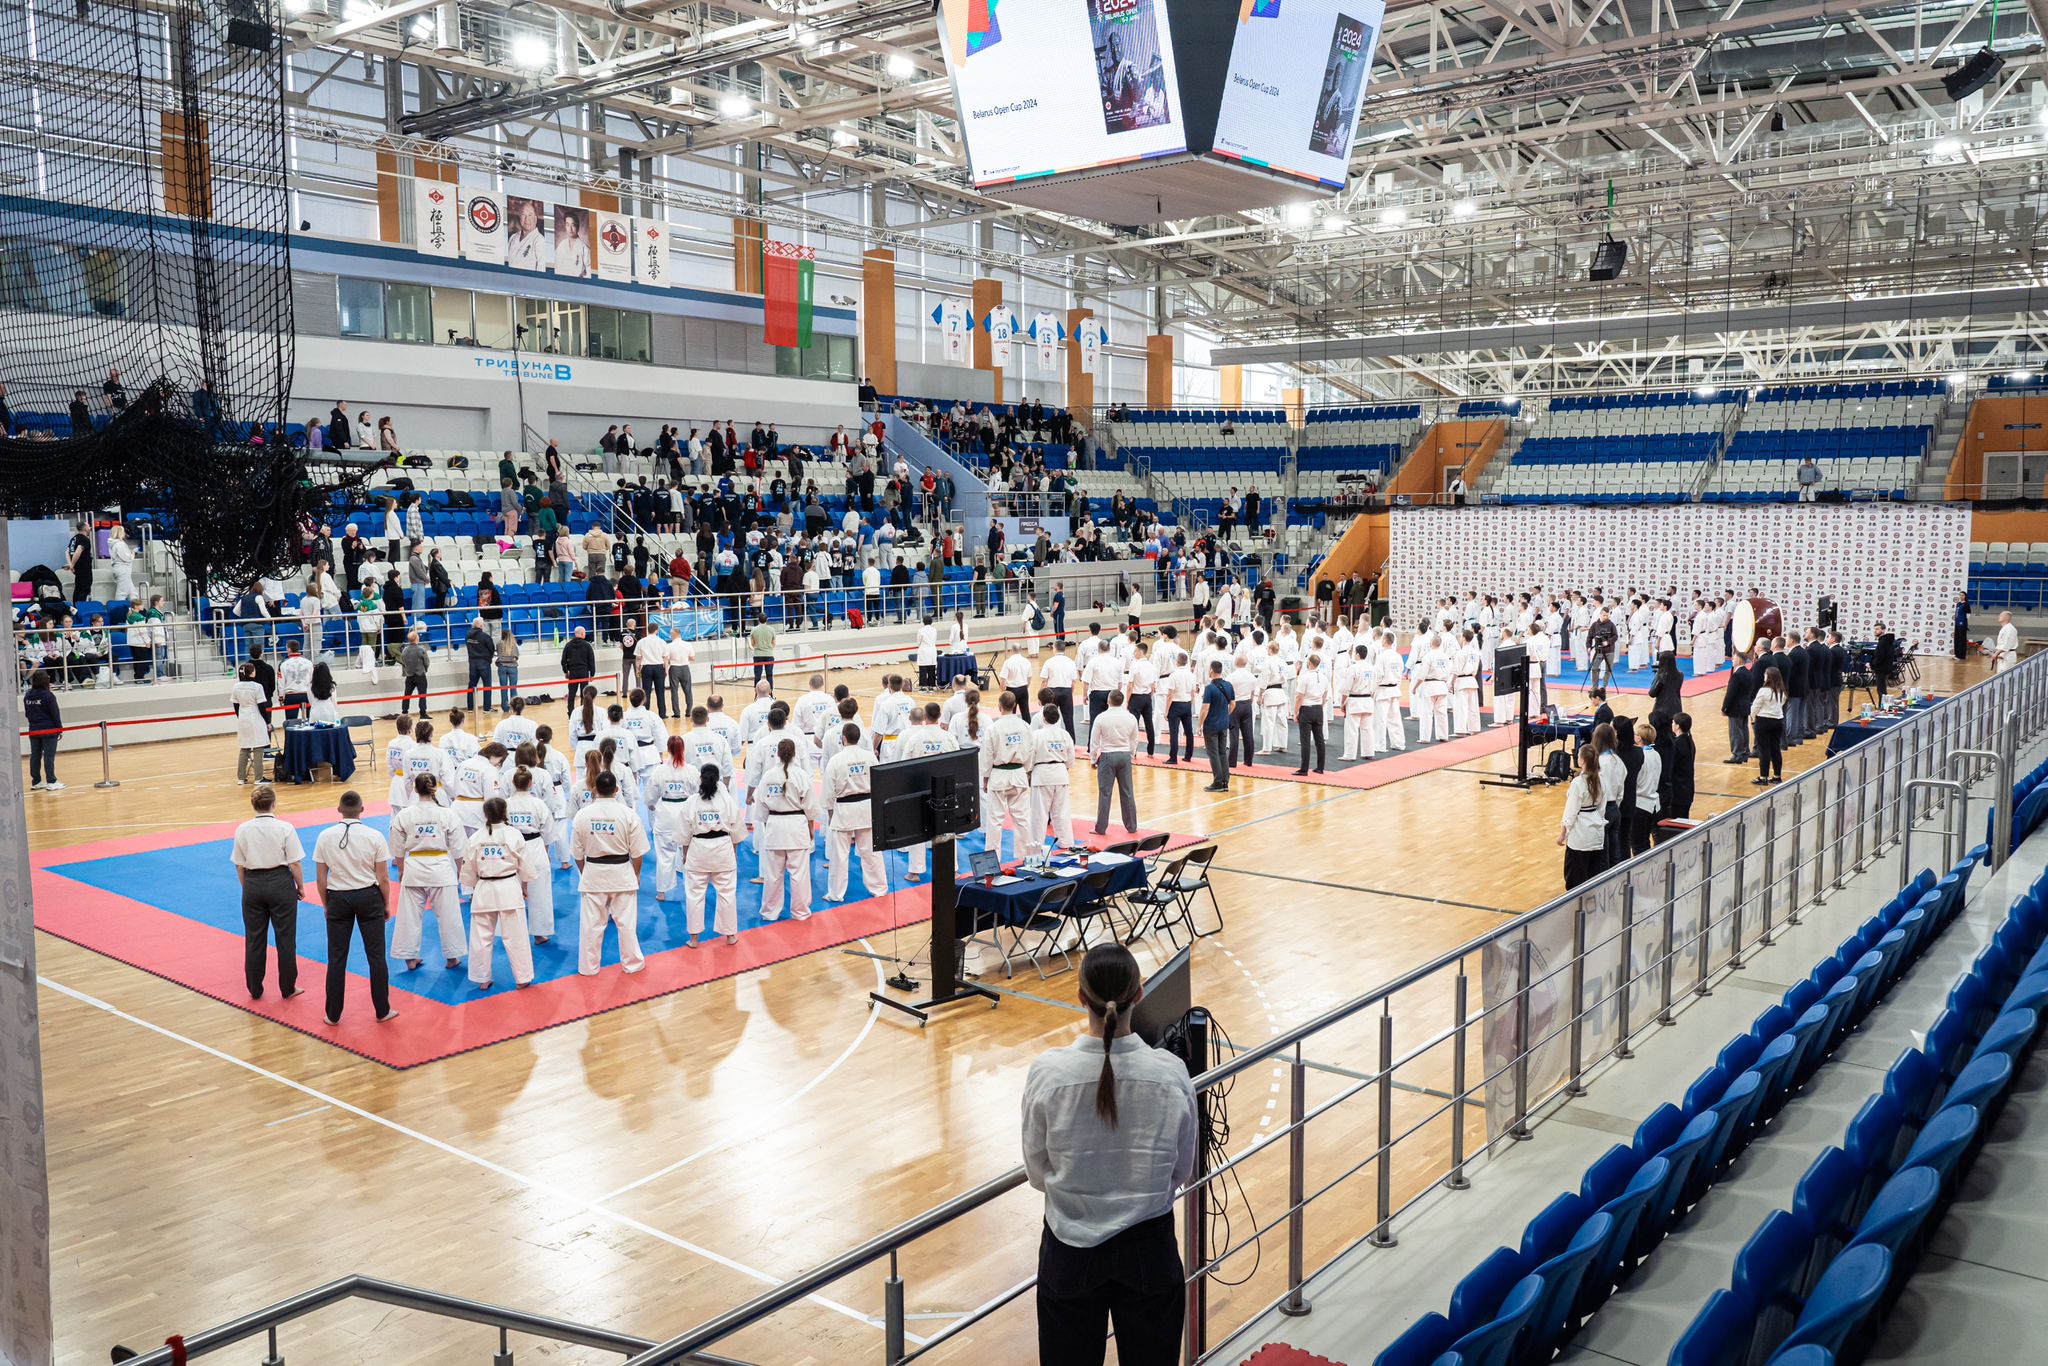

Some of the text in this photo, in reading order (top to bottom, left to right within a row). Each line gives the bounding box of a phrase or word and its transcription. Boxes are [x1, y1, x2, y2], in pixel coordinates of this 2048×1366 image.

[1342, 28, 1362, 48] 2024
[1233, 73, 1280, 96] Belarus Open Cup 2024
[972, 98, 1038, 119] Belarus Open Cup 2024
[952, 321, 957, 332] 7
[997, 328, 1008, 339] 18
[1042, 333, 1051, 344] 15
[1088, 338, 1093, 347] 2
[474, 358, 553, 371] ТРИБУНА
[412, 761, 428, 769] 909
[849, 766, 865, 774] 957
[510, 815, 532, 823] 1032
[699, 813, 720, 822] 1009
[418, 825, 435, 834] 942
[591, 822, 615, 832] 1024
[484, 847, 503, 857] 894
